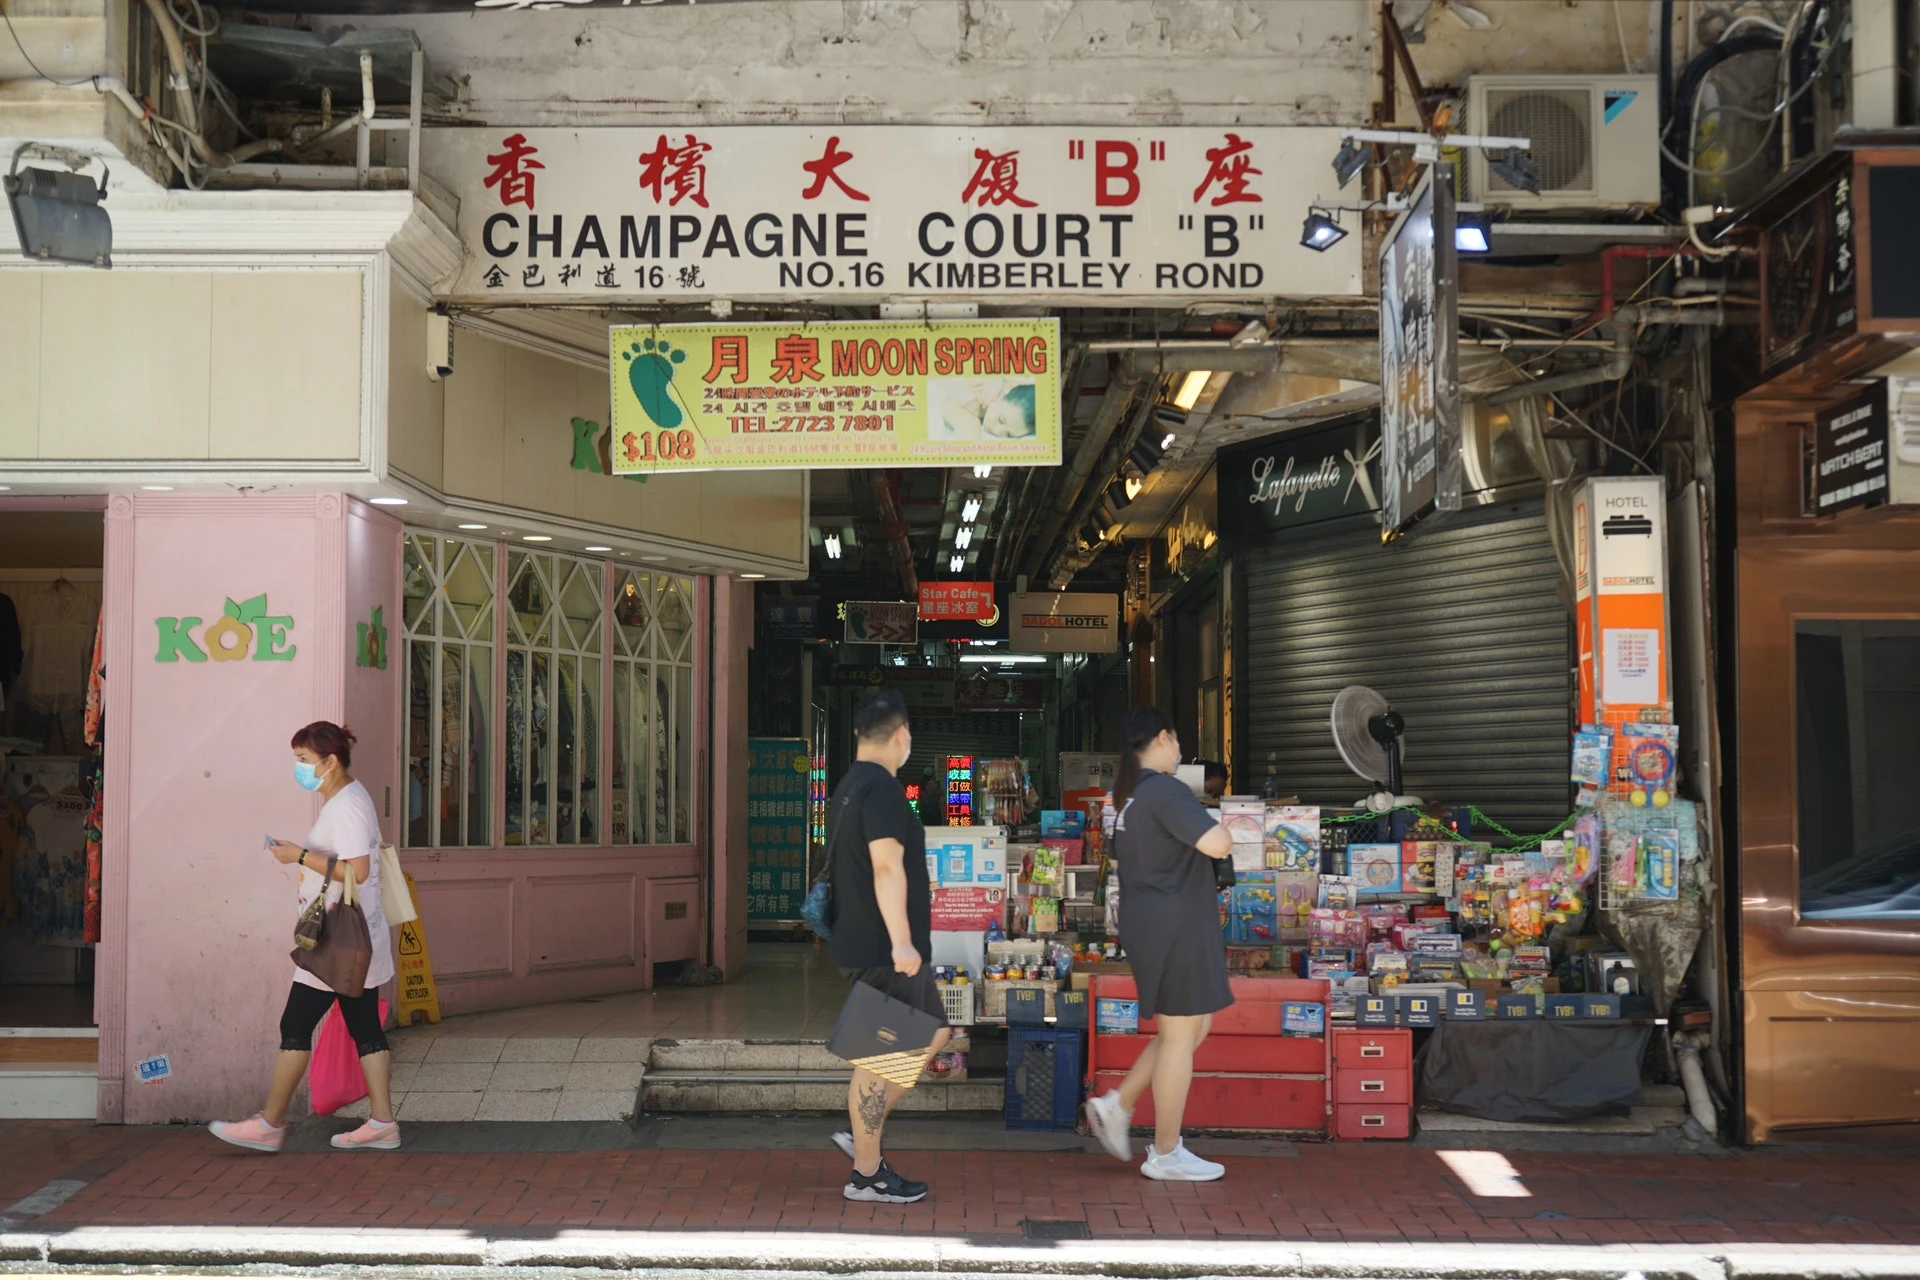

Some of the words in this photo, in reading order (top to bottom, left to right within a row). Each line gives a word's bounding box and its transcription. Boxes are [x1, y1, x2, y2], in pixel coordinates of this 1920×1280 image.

[482, 212, 868, 258] CHAMPAGNE
[918, 212, 1133, 258] COURT
[1178, 214, 1264, 257] "B"
[780, 262, 884, 288] NO.16
[907, 263, 1130, 288] KIMBERLEY
[1156, 263, 1264, 288] ROND
[702, 334, 825, 384] 月泉
[832, 339, 928, 376] MOON
[935, 336, 1048, 375] SPRING
[702, 403, 723, 414] 24
[840, 414, 894, 431] 7801
[621, 431, 696, 462] $108
[1249, 455, 1340, 516] Lafayette
[1606, 497, 1648, 508] HOTEL
[922, 588, 947, 599] Star
[951, 588, 978, 599] Cafe
[922, 601, 978, 614] 星座冰室
